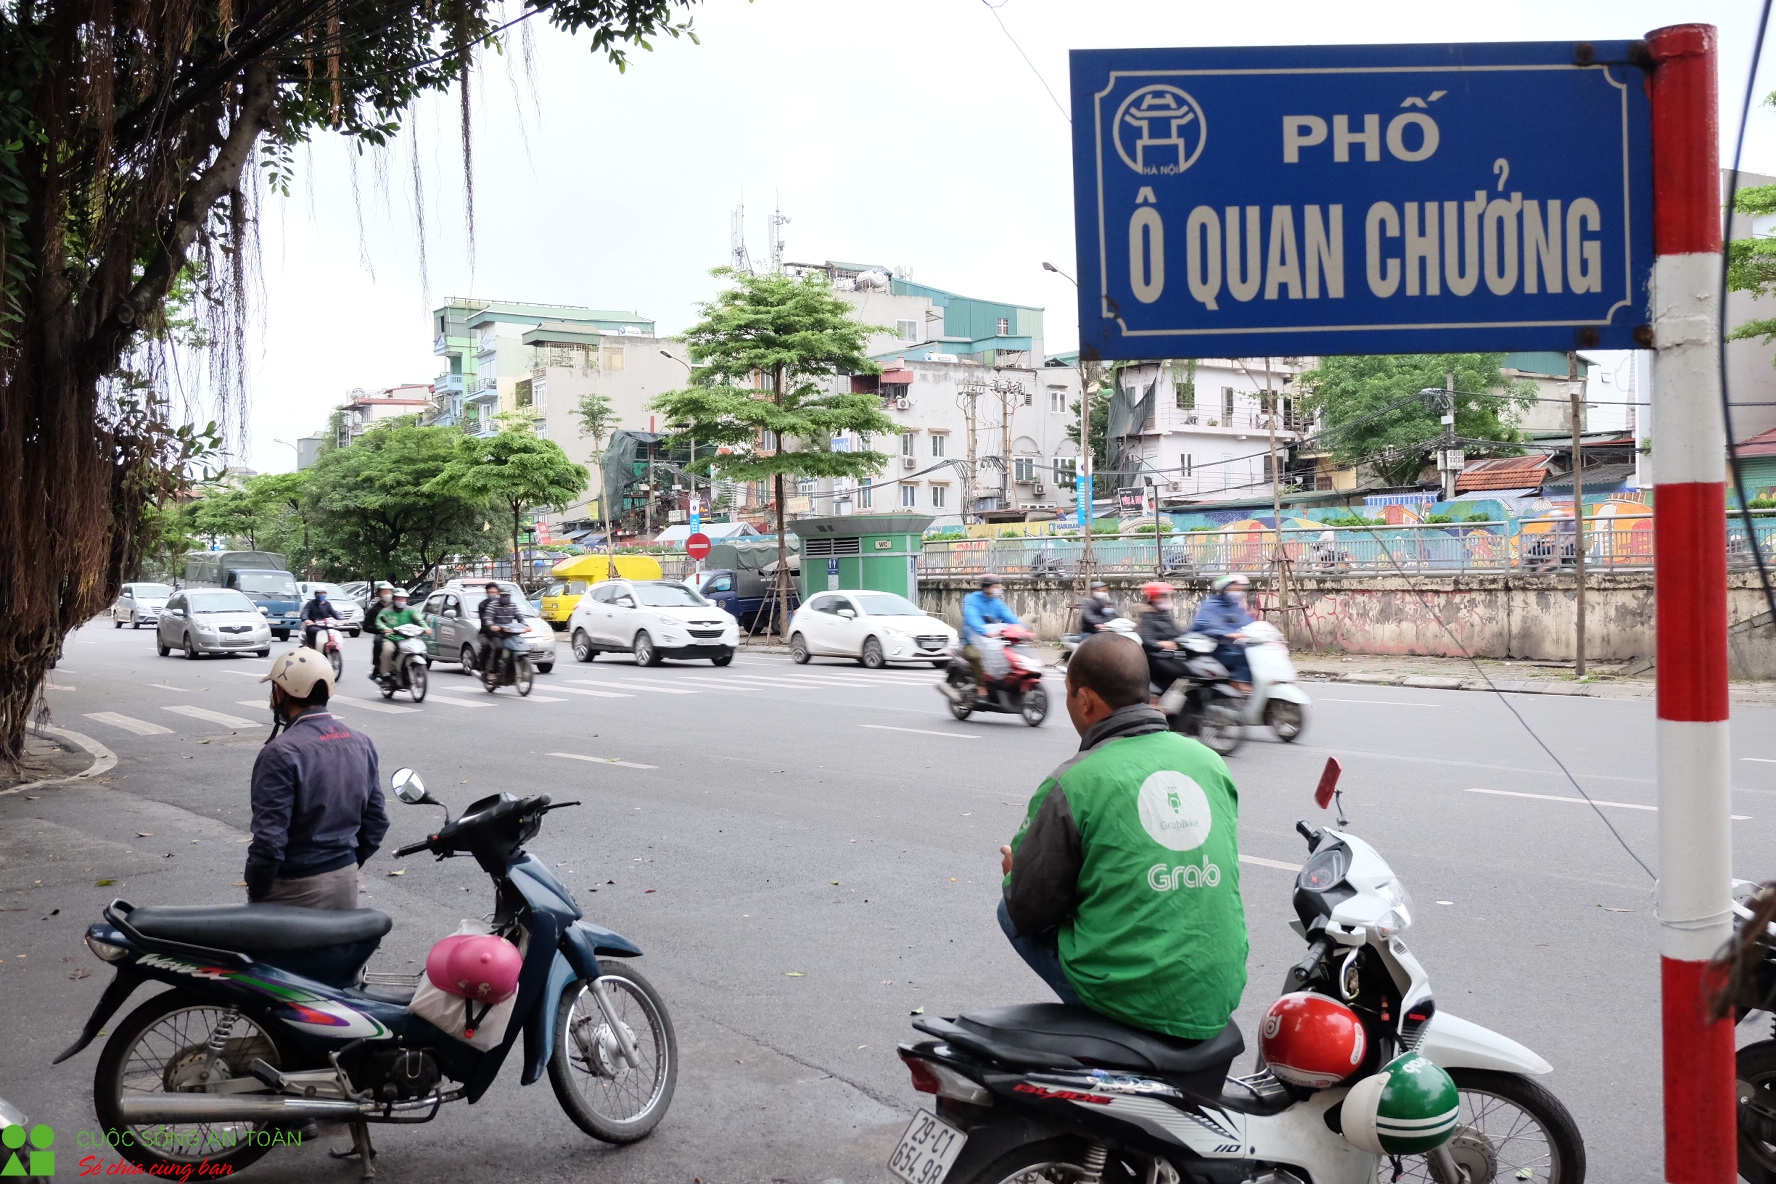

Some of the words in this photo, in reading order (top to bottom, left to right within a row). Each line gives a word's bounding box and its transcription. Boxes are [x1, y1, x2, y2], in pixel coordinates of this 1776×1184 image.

[1283, 90, 1448, 163] PHỐ
[1143, 164, 1158, 175] HÀ
[1128, 186, 1165, 304] Ô
[1186, 203, 1345, 311] QUAN
[1365, 158, 1602, 297] CHƯỞNG
[1160, 819, 1200, 830] GrabBike
[1147, 854, 1221, 892] Grab
[911, 1116, 956, 1159] 29-C1
[1213, 1144, 1242, 1153] 110
[892, 1142, 943, 1184] 654.98
